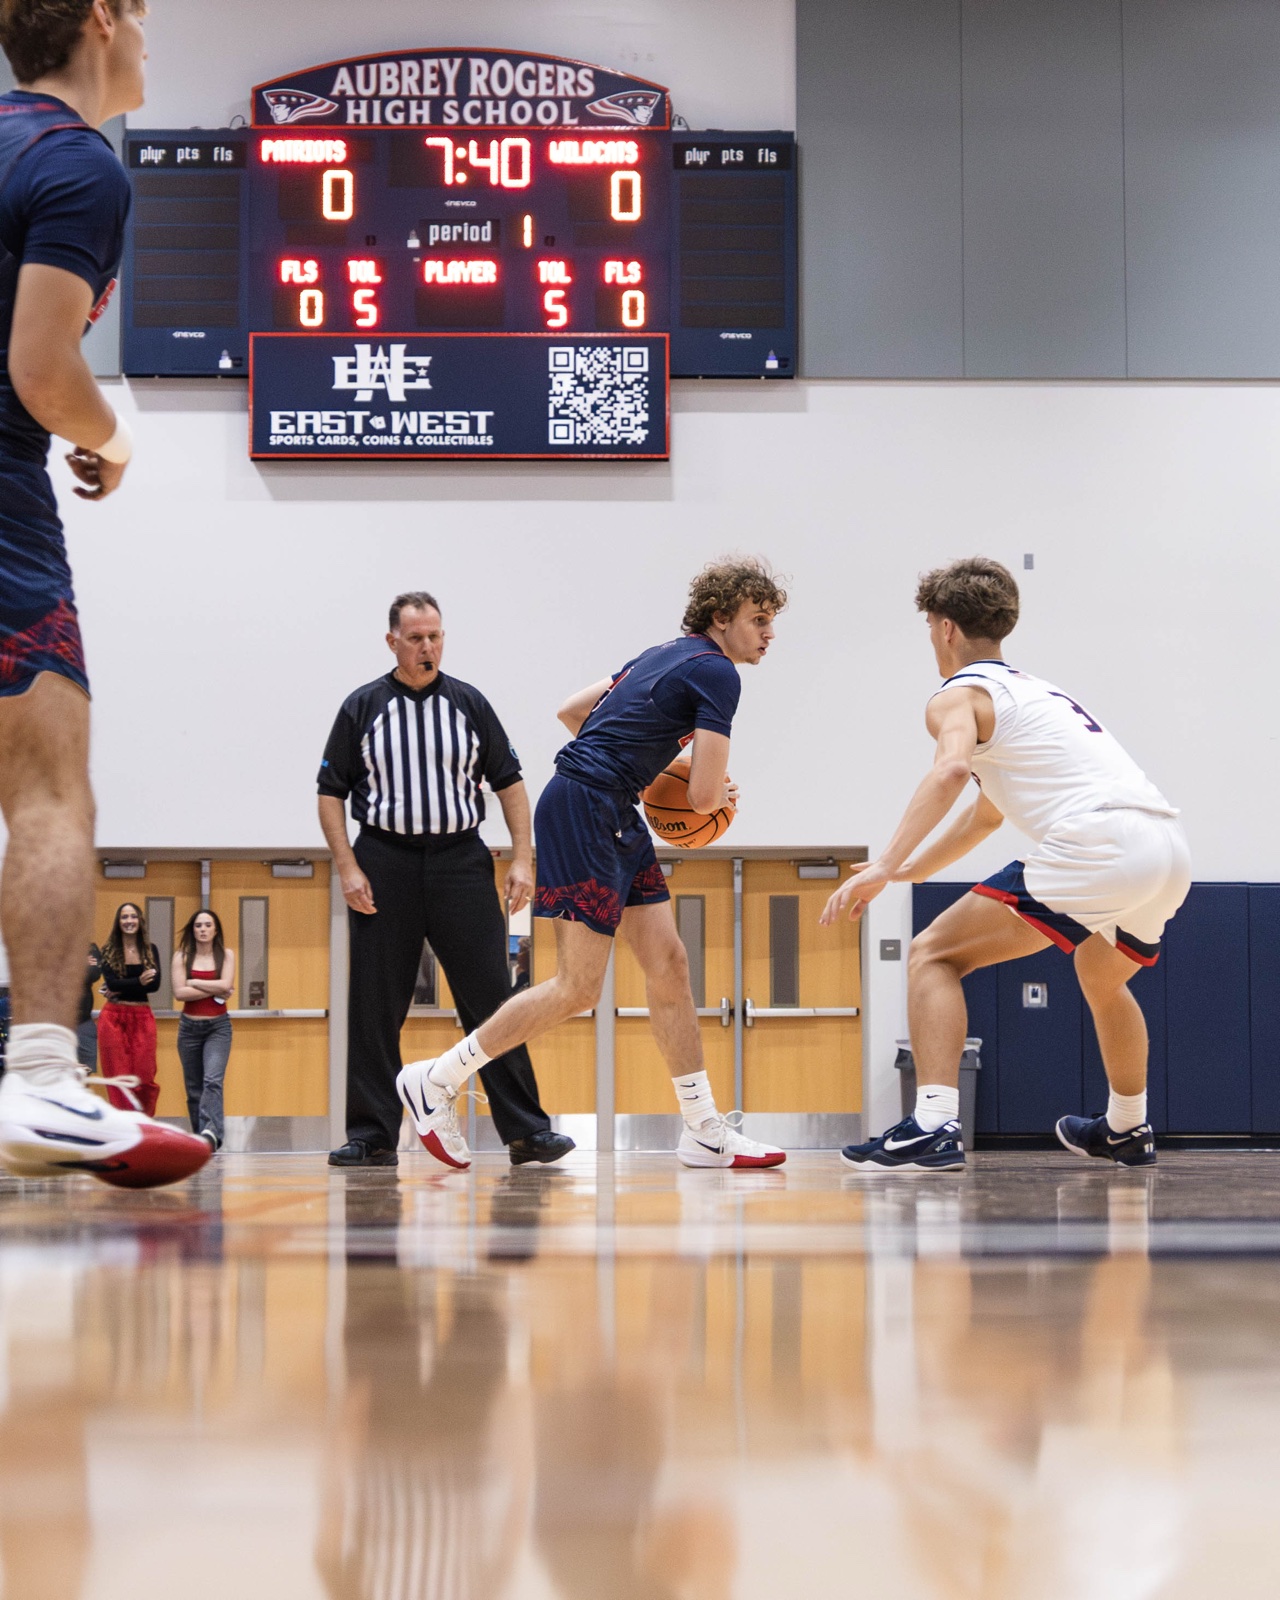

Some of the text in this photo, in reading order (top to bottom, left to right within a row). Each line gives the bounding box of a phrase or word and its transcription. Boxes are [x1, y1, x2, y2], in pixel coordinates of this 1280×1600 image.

[330, 58, 595, 97] AUBREY ROGERS
[345, 100, 579, 126] HIGH SCHOOL
[140, 146, 233, 164] plyr pts fls
[260, 139, 347, 163] PATRIOTS
[425, 136, 531, 188] 7:40
[548, 140, 639, 165] WILDCATS
[684, 148, 777, 165] plyr pts fls
[322, 169, 354, 221] 0
[610, 170, 642, 221] 0
[428, 221, 492, 247] period
[523, 214, 533, 248] 1
[280, 260, 319, 284] FLS
[348, 260, 382, 284] TOL
[424, 260, 497, 284] PLAYER
[538, 260, 572, 284] TOL
[604, 260, 642, 284] FLS
[299, 289, 325, 327] 0
[353, 289, 379, 328] 5
[543, 289, 568, 328] 5
[621, 289, 646, 327] 0
[269, 410, 495, 435] EAST WEST
[269, 435, 494, 447] SPORTS CARDS, COINS & COLLECTIBLES
